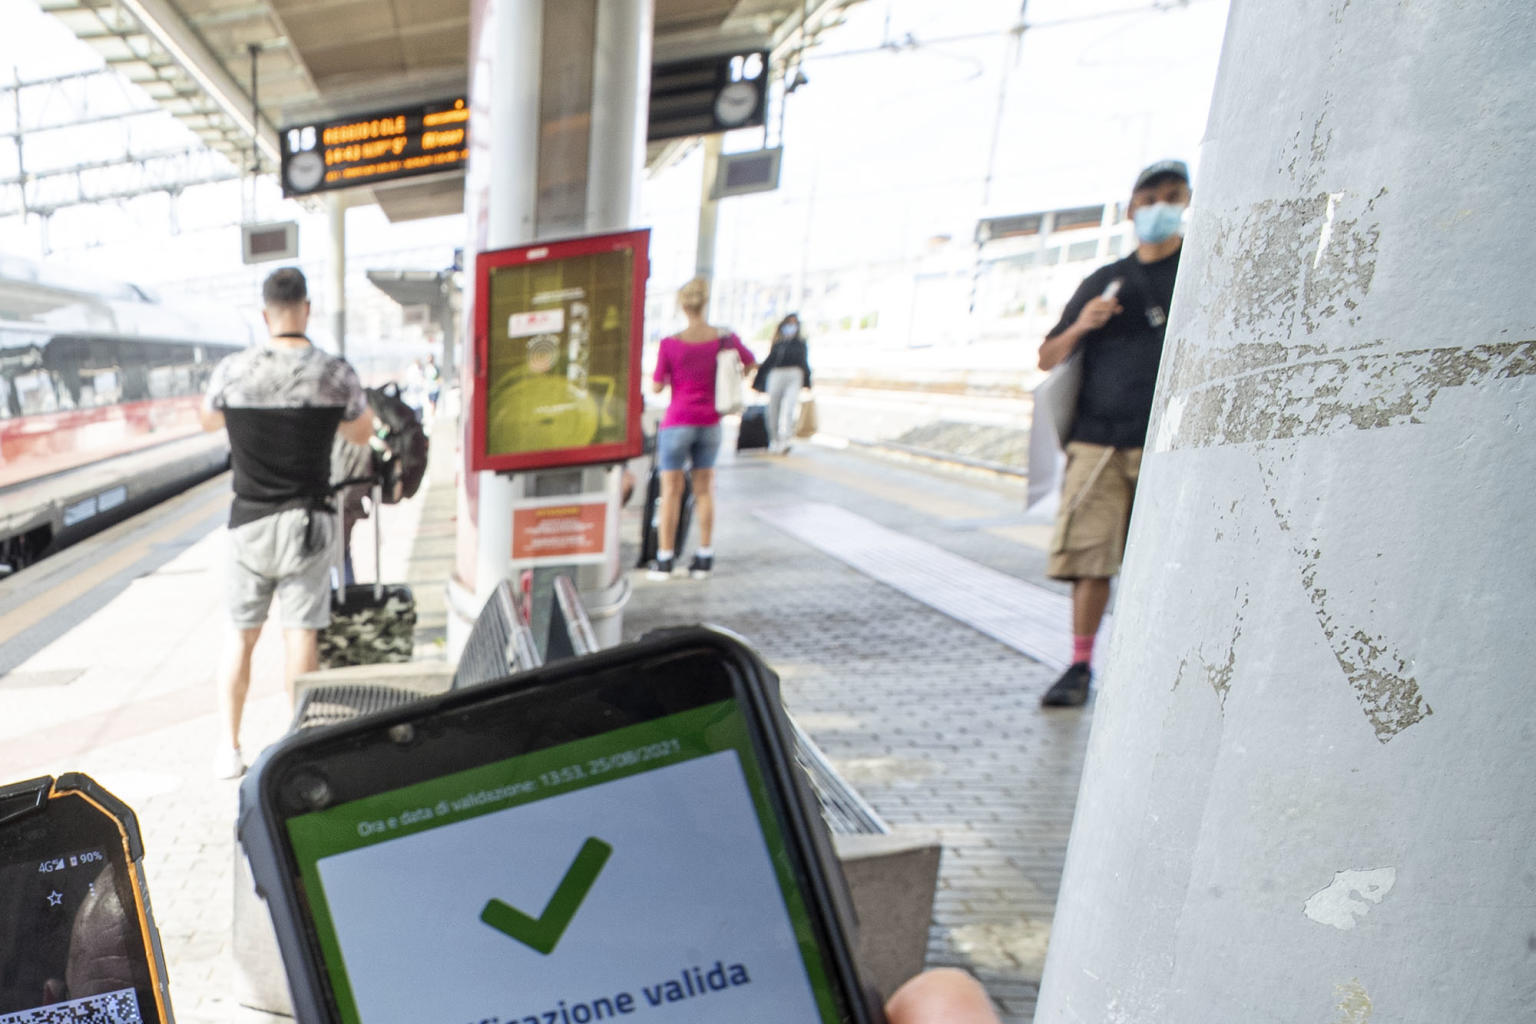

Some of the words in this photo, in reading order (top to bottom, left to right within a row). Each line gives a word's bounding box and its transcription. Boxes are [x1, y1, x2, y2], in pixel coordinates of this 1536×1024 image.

[729, 52, 763, 82] 16
[357, 820, 386, 837] Ora
[388, 816, 398, 829] e
[399, 808, 434, 826] data
[38, 861, 54, 873] 4G
[80, 850, 103, 864] 90%
[643, 960, 752, 1008] valida
